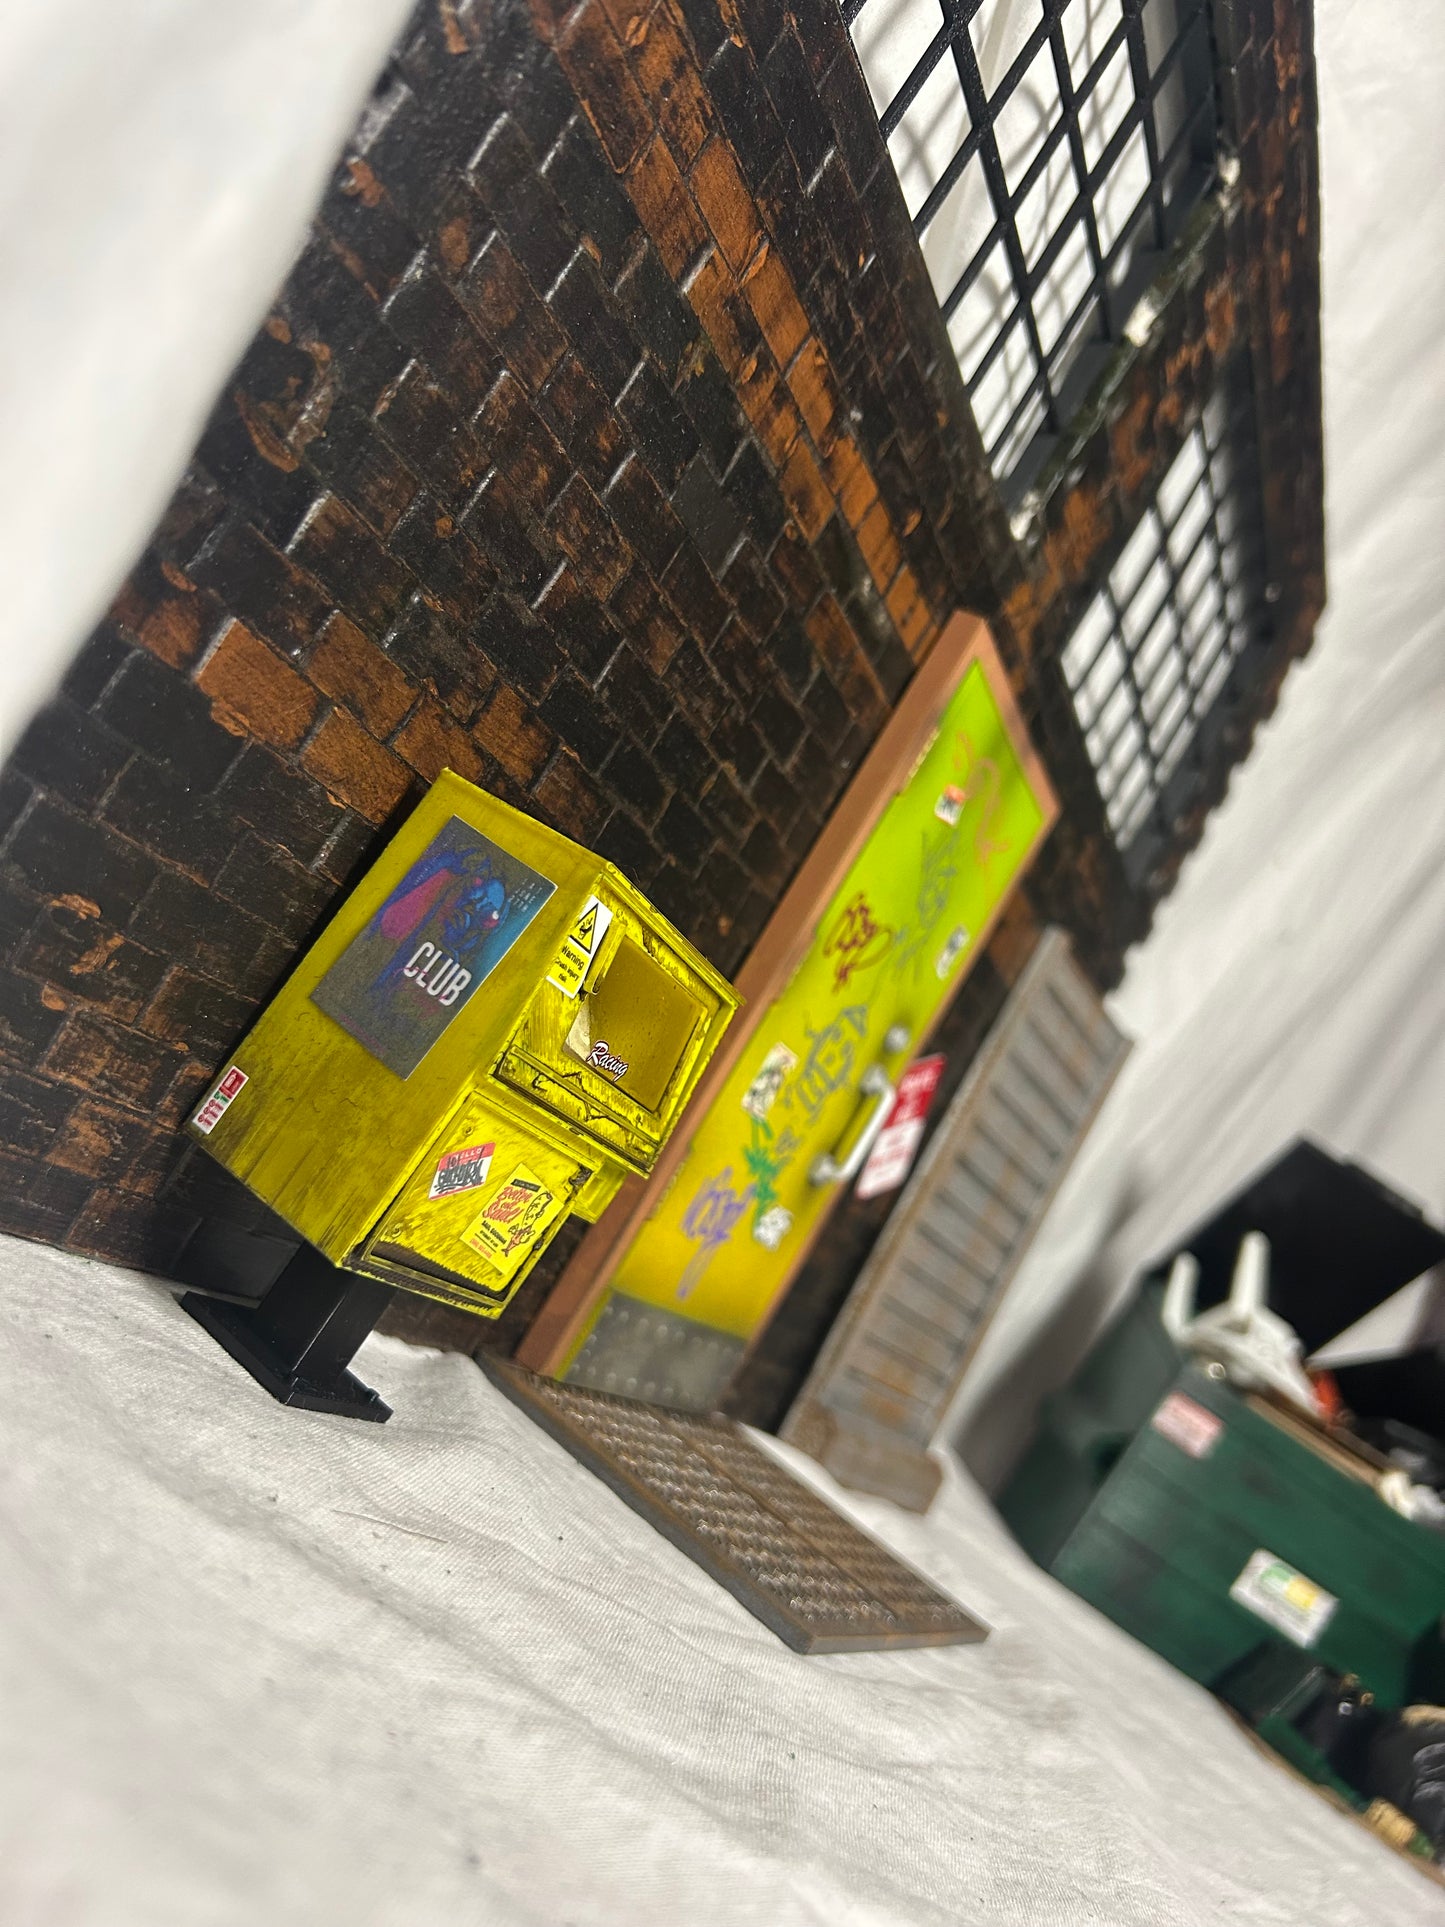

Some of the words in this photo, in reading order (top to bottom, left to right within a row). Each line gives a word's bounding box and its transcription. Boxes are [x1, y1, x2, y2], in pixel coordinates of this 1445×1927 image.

[403, 941, 473, 1006] CLUB
[561, 943, 585, 971] Warning
[587, 1041, 628, 1080] Racing
